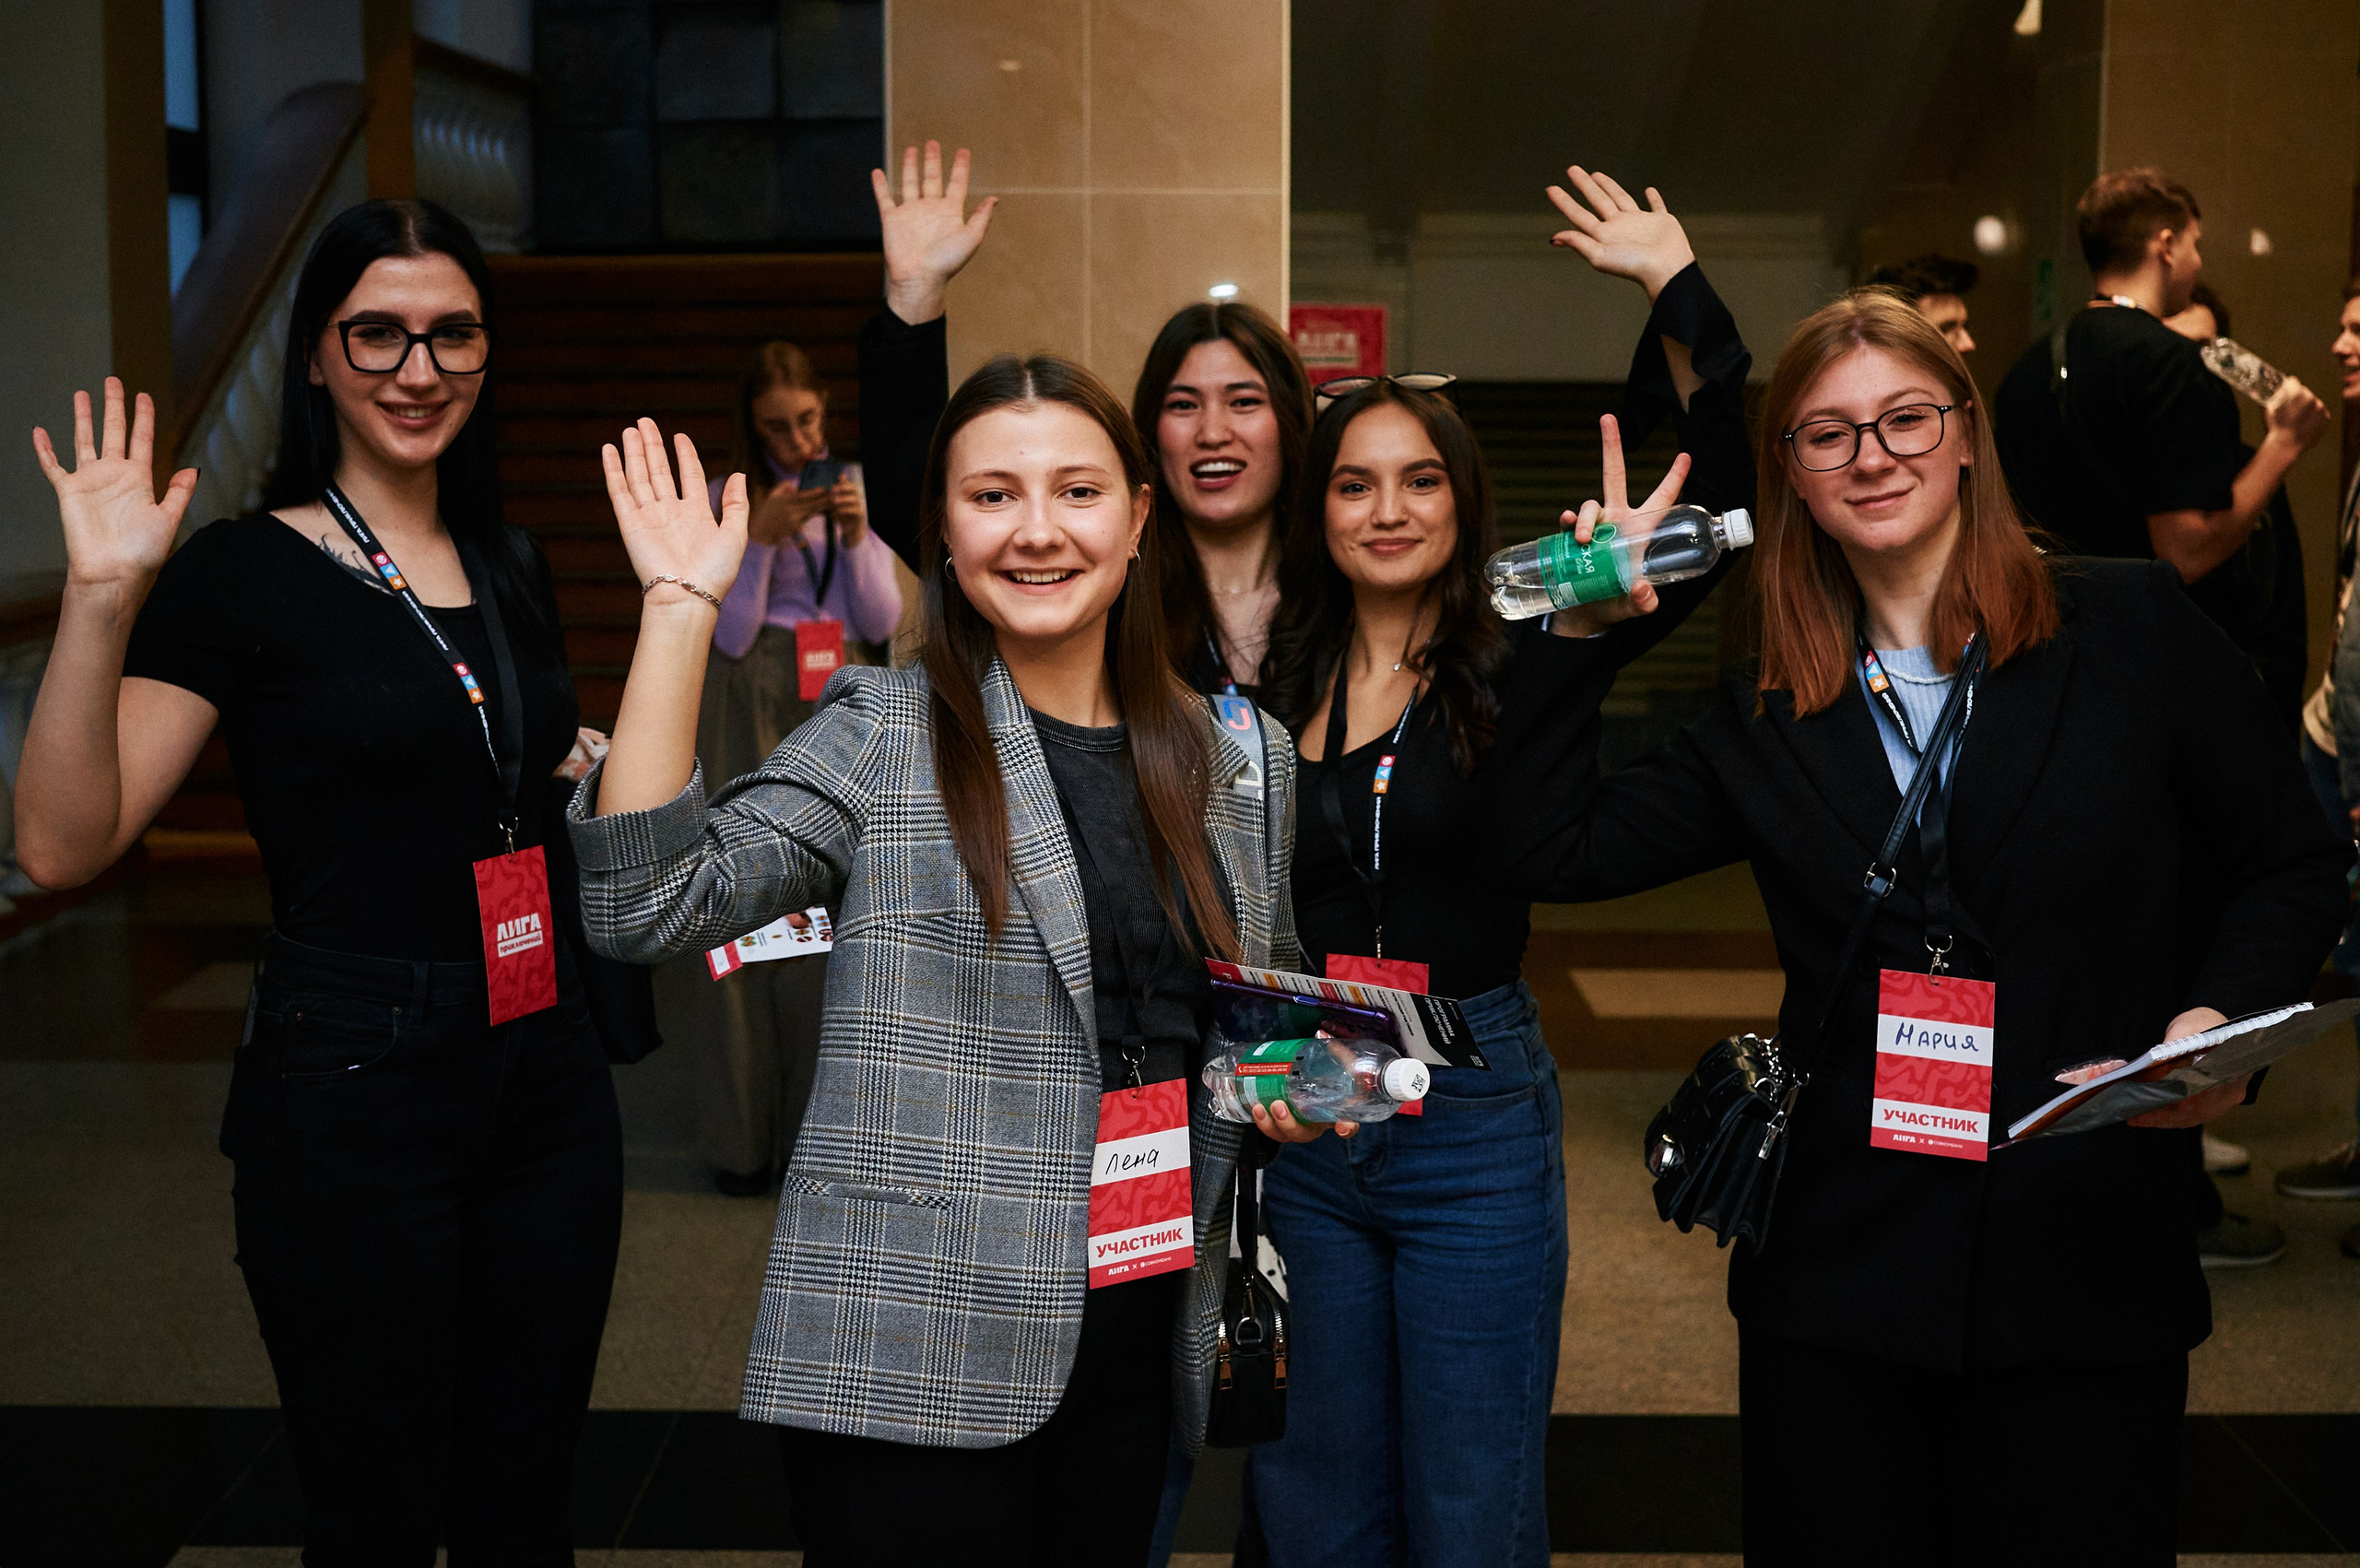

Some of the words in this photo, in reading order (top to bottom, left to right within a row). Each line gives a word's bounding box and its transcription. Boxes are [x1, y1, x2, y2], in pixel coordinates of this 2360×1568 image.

[1580, 543, 1595, 573] СКАЯ
[497, 913, 542, 942] ЛИГА
[1424, 997, 1452, 1044] ПРИКЛЮЧЕНИЙ
[1433, 998, 1456, 1037] ПРОГРАММА
[1883, 1108, 1979, 1134] УЧАСТНИК
[1096, 1227, 1184, 1258] УЧАСТНИК
